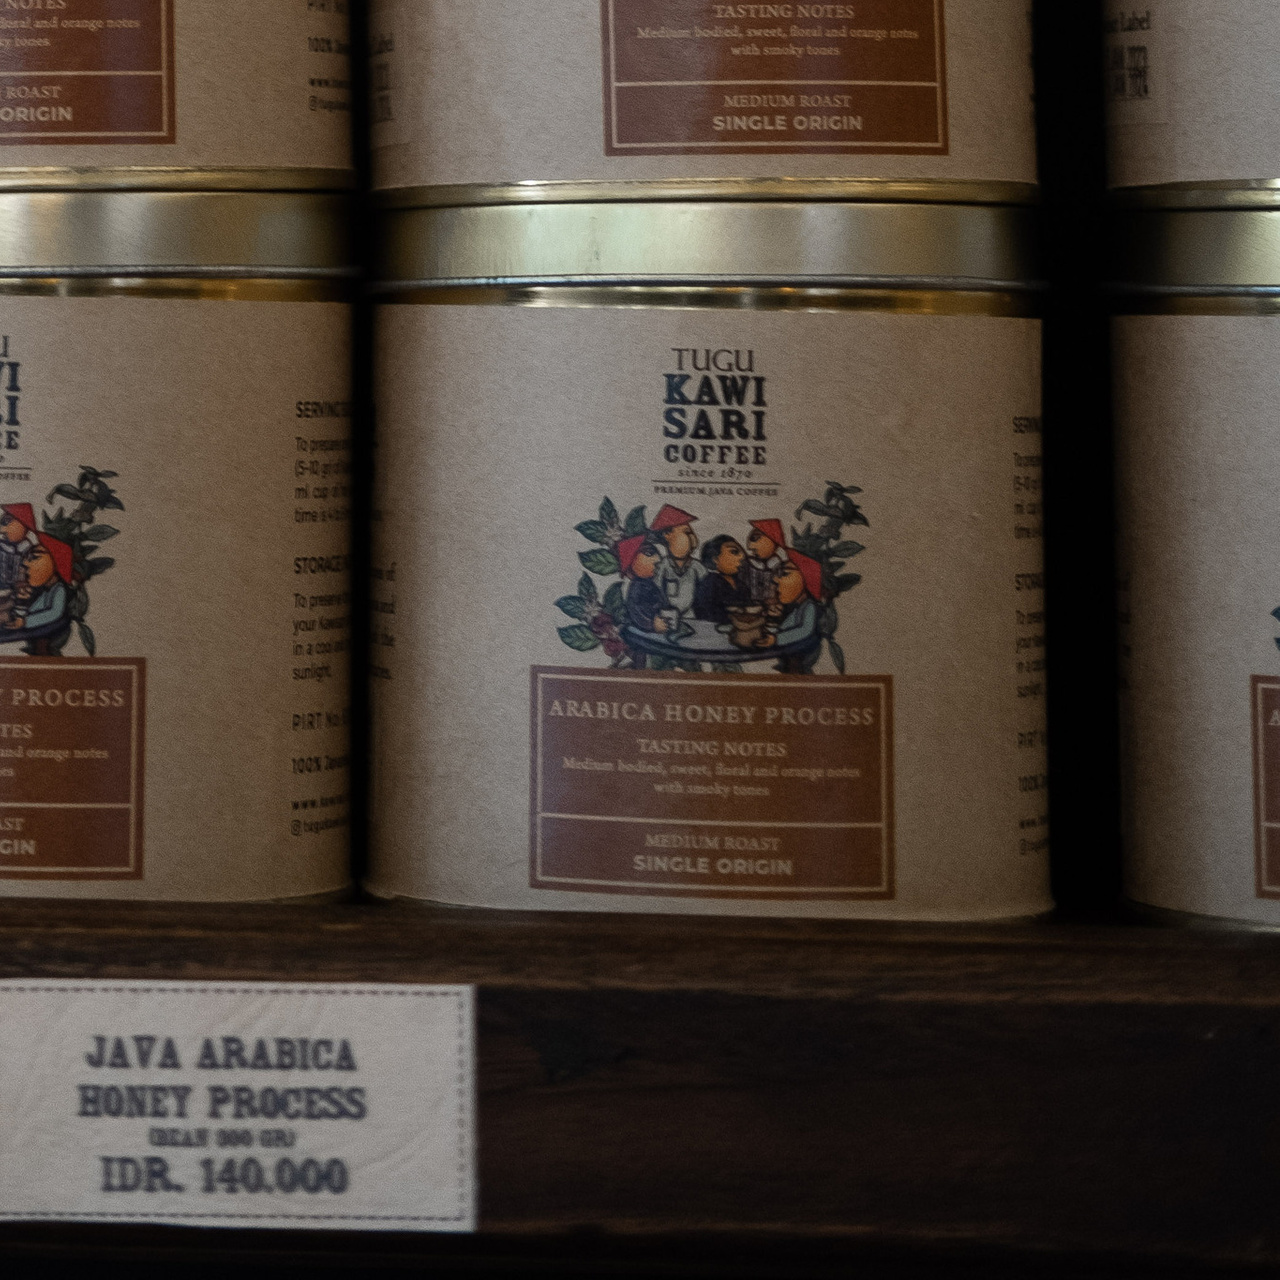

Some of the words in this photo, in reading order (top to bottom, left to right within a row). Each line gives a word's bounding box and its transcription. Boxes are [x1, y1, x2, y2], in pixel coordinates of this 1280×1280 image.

[713, 4, 792, 19] TASTING
[796, 4, 855, 19] NOTES
[6, 86, 62, 99] ROAST
[723, 95, 795, 107] MEDIUM
[799, 95, 852, 107] ROAST
[712, 115, 787, 131] SINGLE
[793, 115, 863, 131] ORIGIN
[671, 348, 754, 372] TUGU
[663, 373, 767, 407] KAWI
[662, 407, 767, 441] SARI
[664, 444, 767, 464] COFFEE
[11, 689, 125, 708] PROCESS
[549, 700, 655, 721] ARABICA
[664, 705, 757, 725] HONEY
[766, 706, 875, 726] PROCESS
[636, 738, 717, 755] TASTING
[722, 741, 787, 758] NOTES
[645, 833, 720, 850] MEDIUM
[724, 836, 780, 852] ROAST
[633, 855, 709, 873] SINGLE
[715, 857, 792, 876] ORIGIN
[85, 1035, 181, 1070] JAVA
[197, 1037, 357, 1071] ARABICA
[77, 1083, 192, 1118] HONEY
[209, 1086, 367, 1120] PROCESS
[100, 1155, 185, 1193] IDR.
[200, 1157, 347, 1195] 140.000
